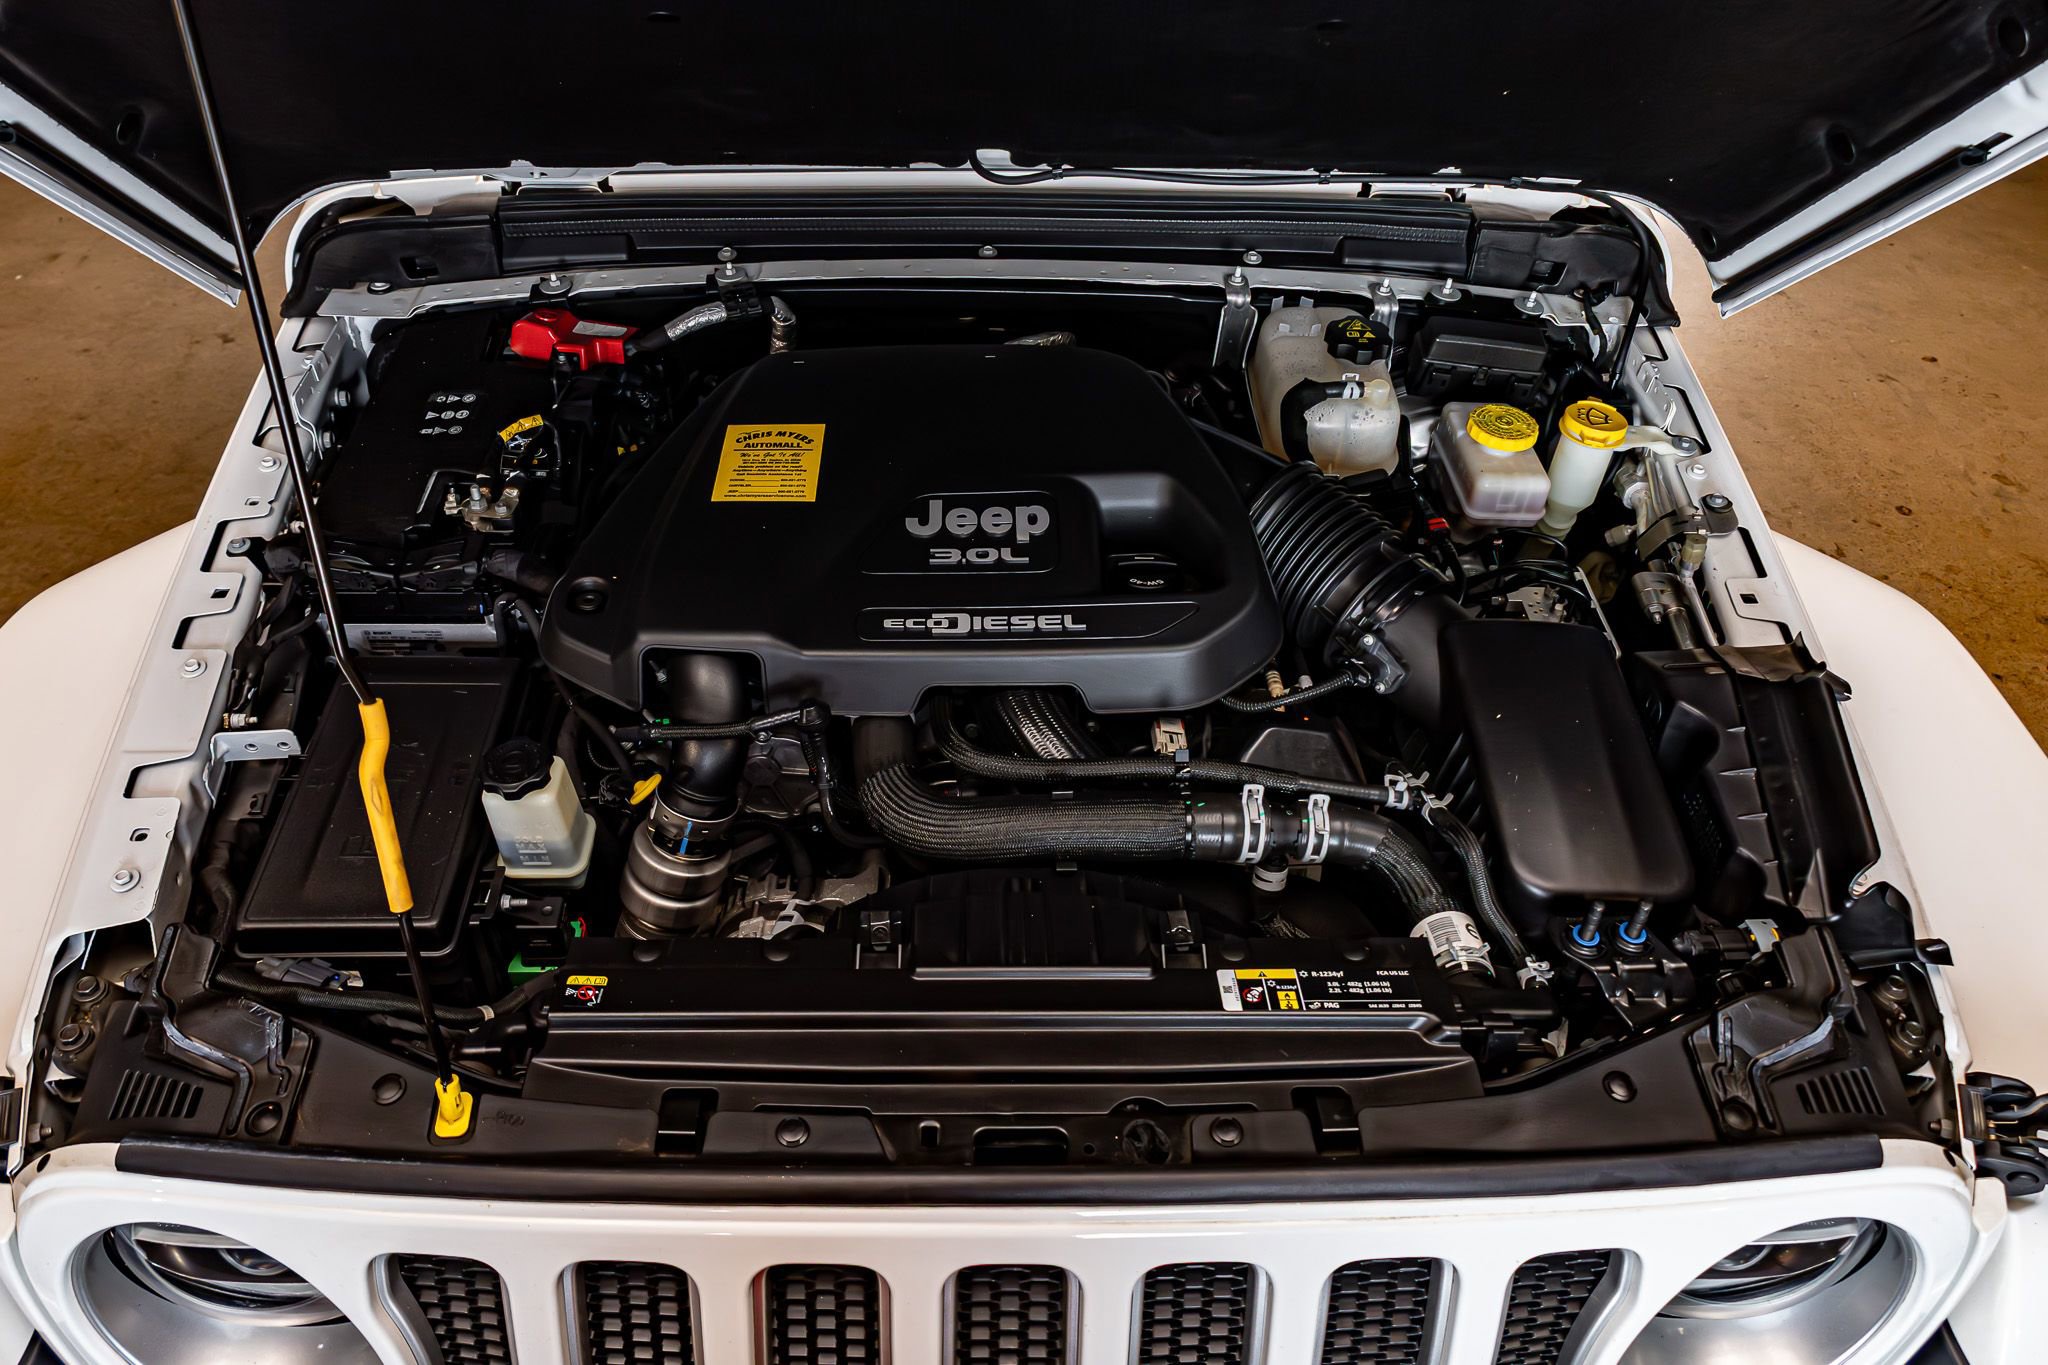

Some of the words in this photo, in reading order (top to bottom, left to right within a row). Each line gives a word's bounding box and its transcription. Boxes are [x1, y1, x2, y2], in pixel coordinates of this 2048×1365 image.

[736, 430, 773, 444] CHRIS
[774, 430, 815, 445] MYERS
[905, 499, 1050, 543] Jeep
[929, 547, 1030, 564] 3.0L
[1311, 970, 1344, 978] R-1234yf
